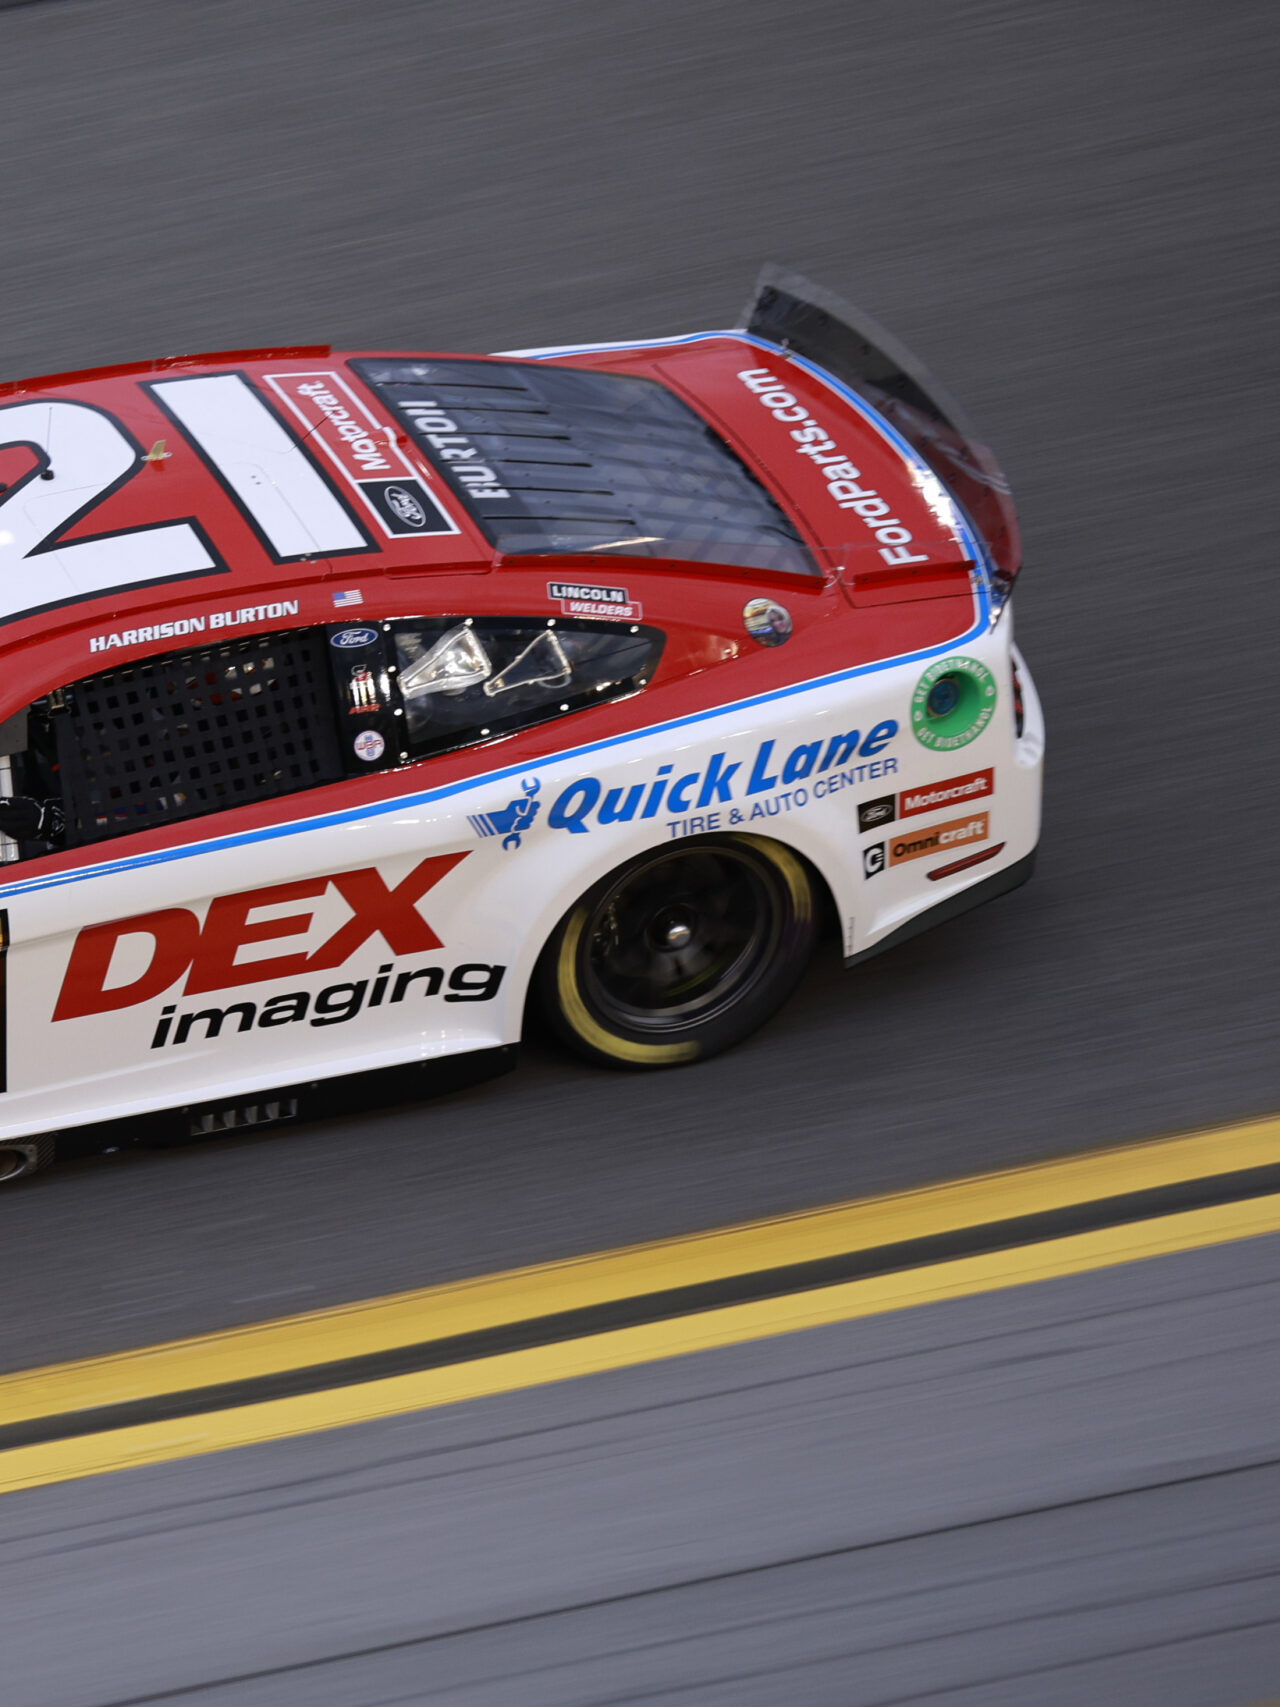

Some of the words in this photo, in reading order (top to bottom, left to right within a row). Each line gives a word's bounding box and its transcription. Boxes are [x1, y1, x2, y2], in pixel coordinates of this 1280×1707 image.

[296, 380, 391, 471] Motorcraft
[736, 368, 930, 566] FordParts.com
[89, 616, 205, 653] HARRISON
[209, 600, 299, 629] BURTON
[552, 585, 624, 603] LINCOLN
[570, 601, 633, 616] WELDERS
[339, 630, 369, 645] Ford
[547, 752, 743, 833] Quick
[745, 719, 899, 796] Lane
[666, 810, 722, 838] TIRE
[729, 808, 744, 825] &
[750, 788, 809, 822] AUTO
[813, 758, 898, 799] CENTER
[904, 778, 989, 811] Motorcraft
[893, 821, 984, 857] Omnicraft
[51, 850, 474, 1022] DEX
[150, 962, 506, 1049] imaging
